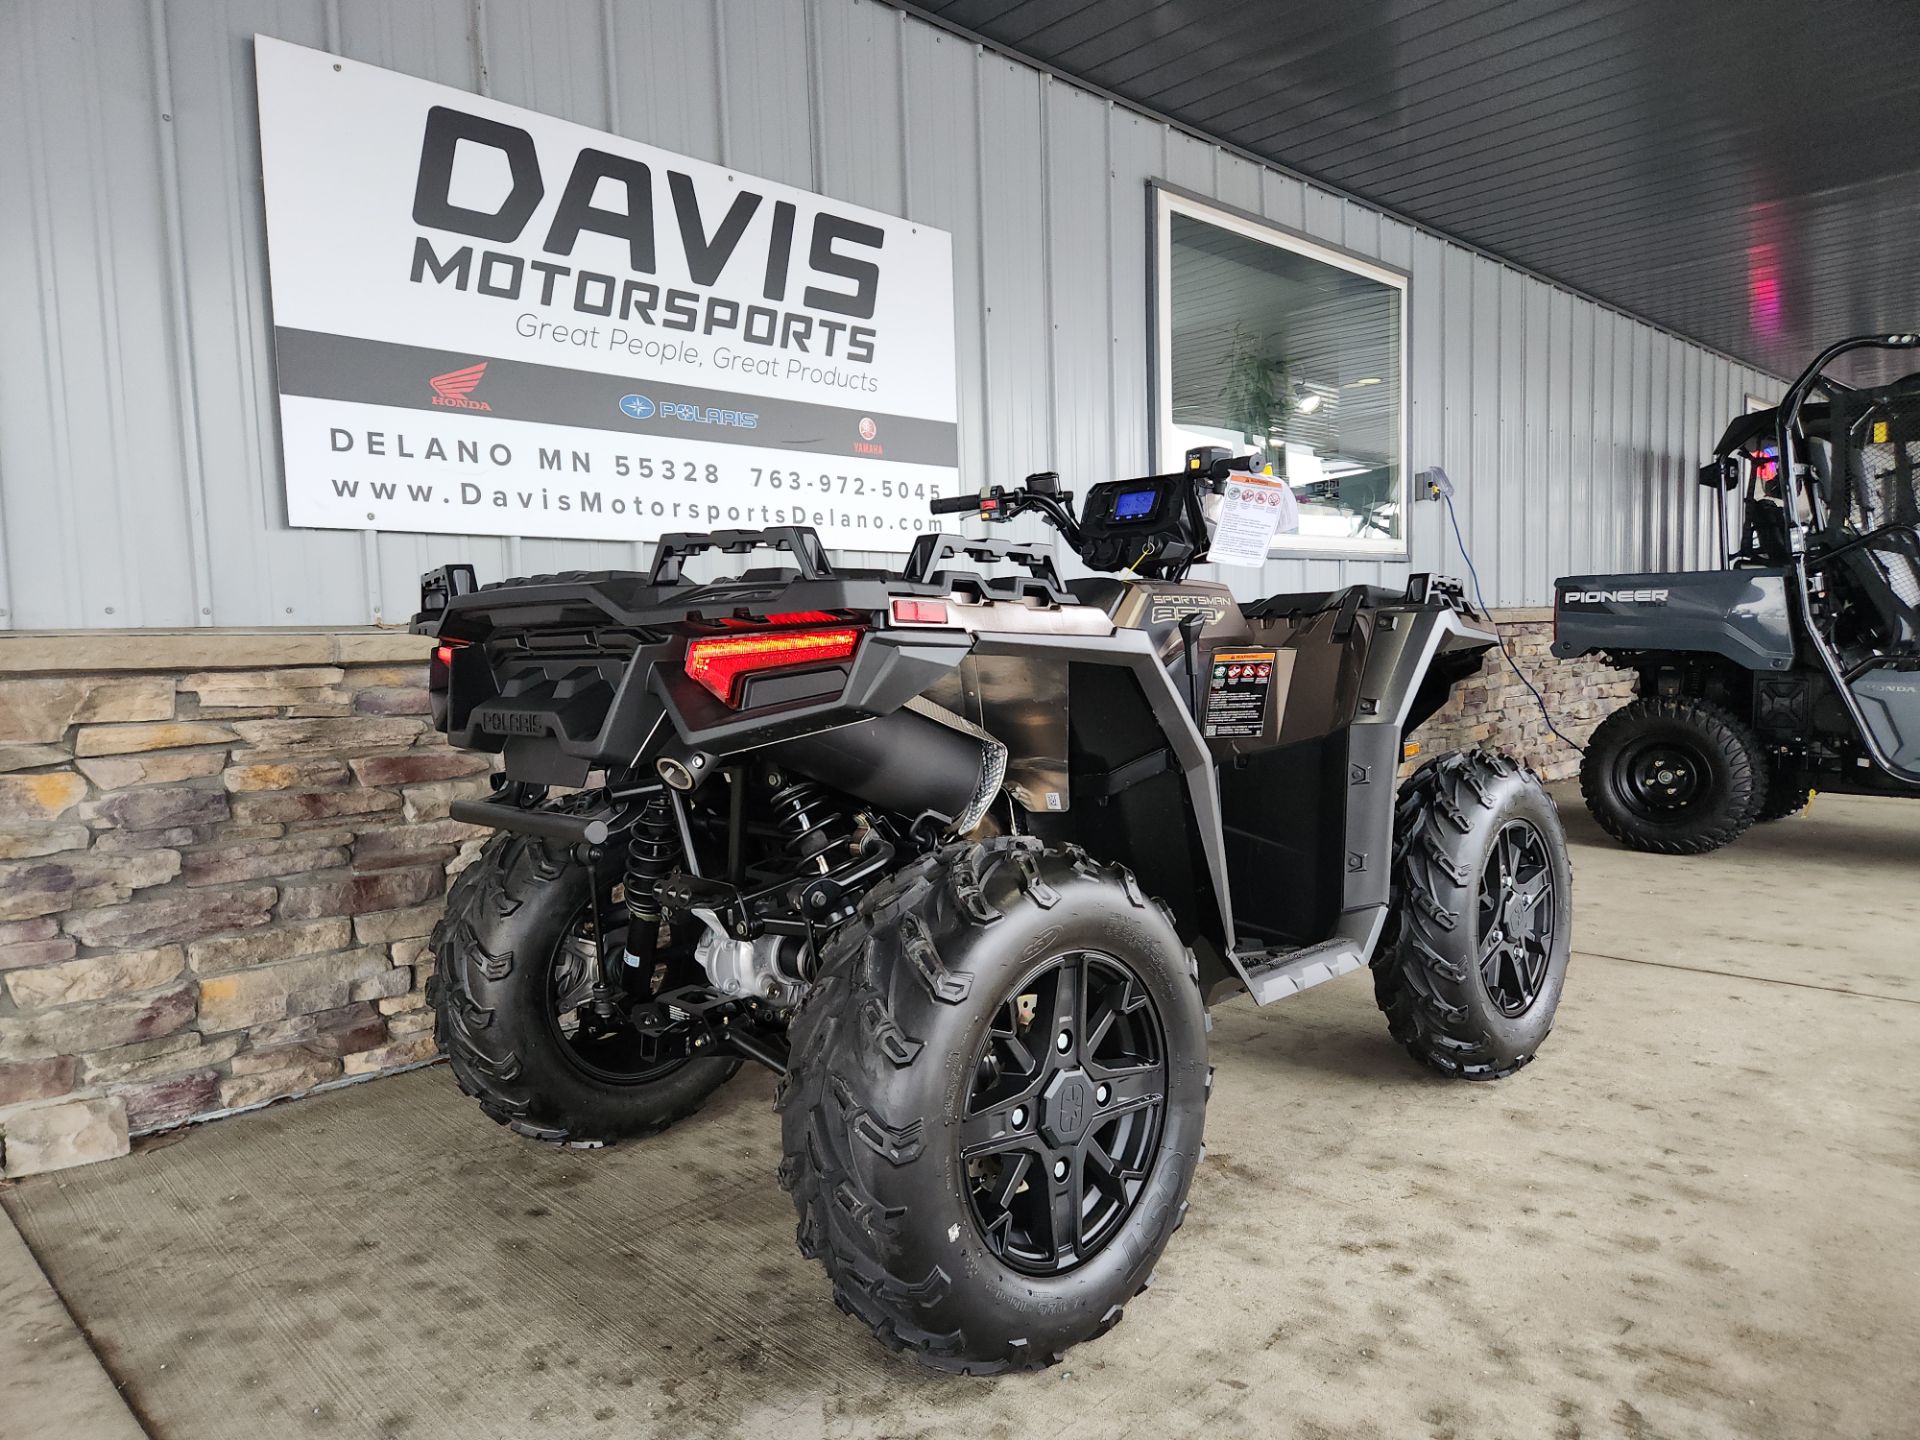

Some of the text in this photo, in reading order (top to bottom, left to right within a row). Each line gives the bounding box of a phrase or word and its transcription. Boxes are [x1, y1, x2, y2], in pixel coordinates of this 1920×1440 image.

[412, 105, 885, 320] DAVIS
[409, 236, 878, 364] MOTORSPORTS
[515, 313, 879, 393] Great People, Great Products
[431, 396, 493, 412] HONDA
[659, 401, 759, 429] POLARIS
[330, 427, 941, 501] DELANO MN 55328 763-972-5045
[331, 479, 943, 533] www.DavisMotorsportsDelano.com
[1152, 595, 1232, 606] SPORTSMAN
[1564, 589, 1669, 604] PIONEER
